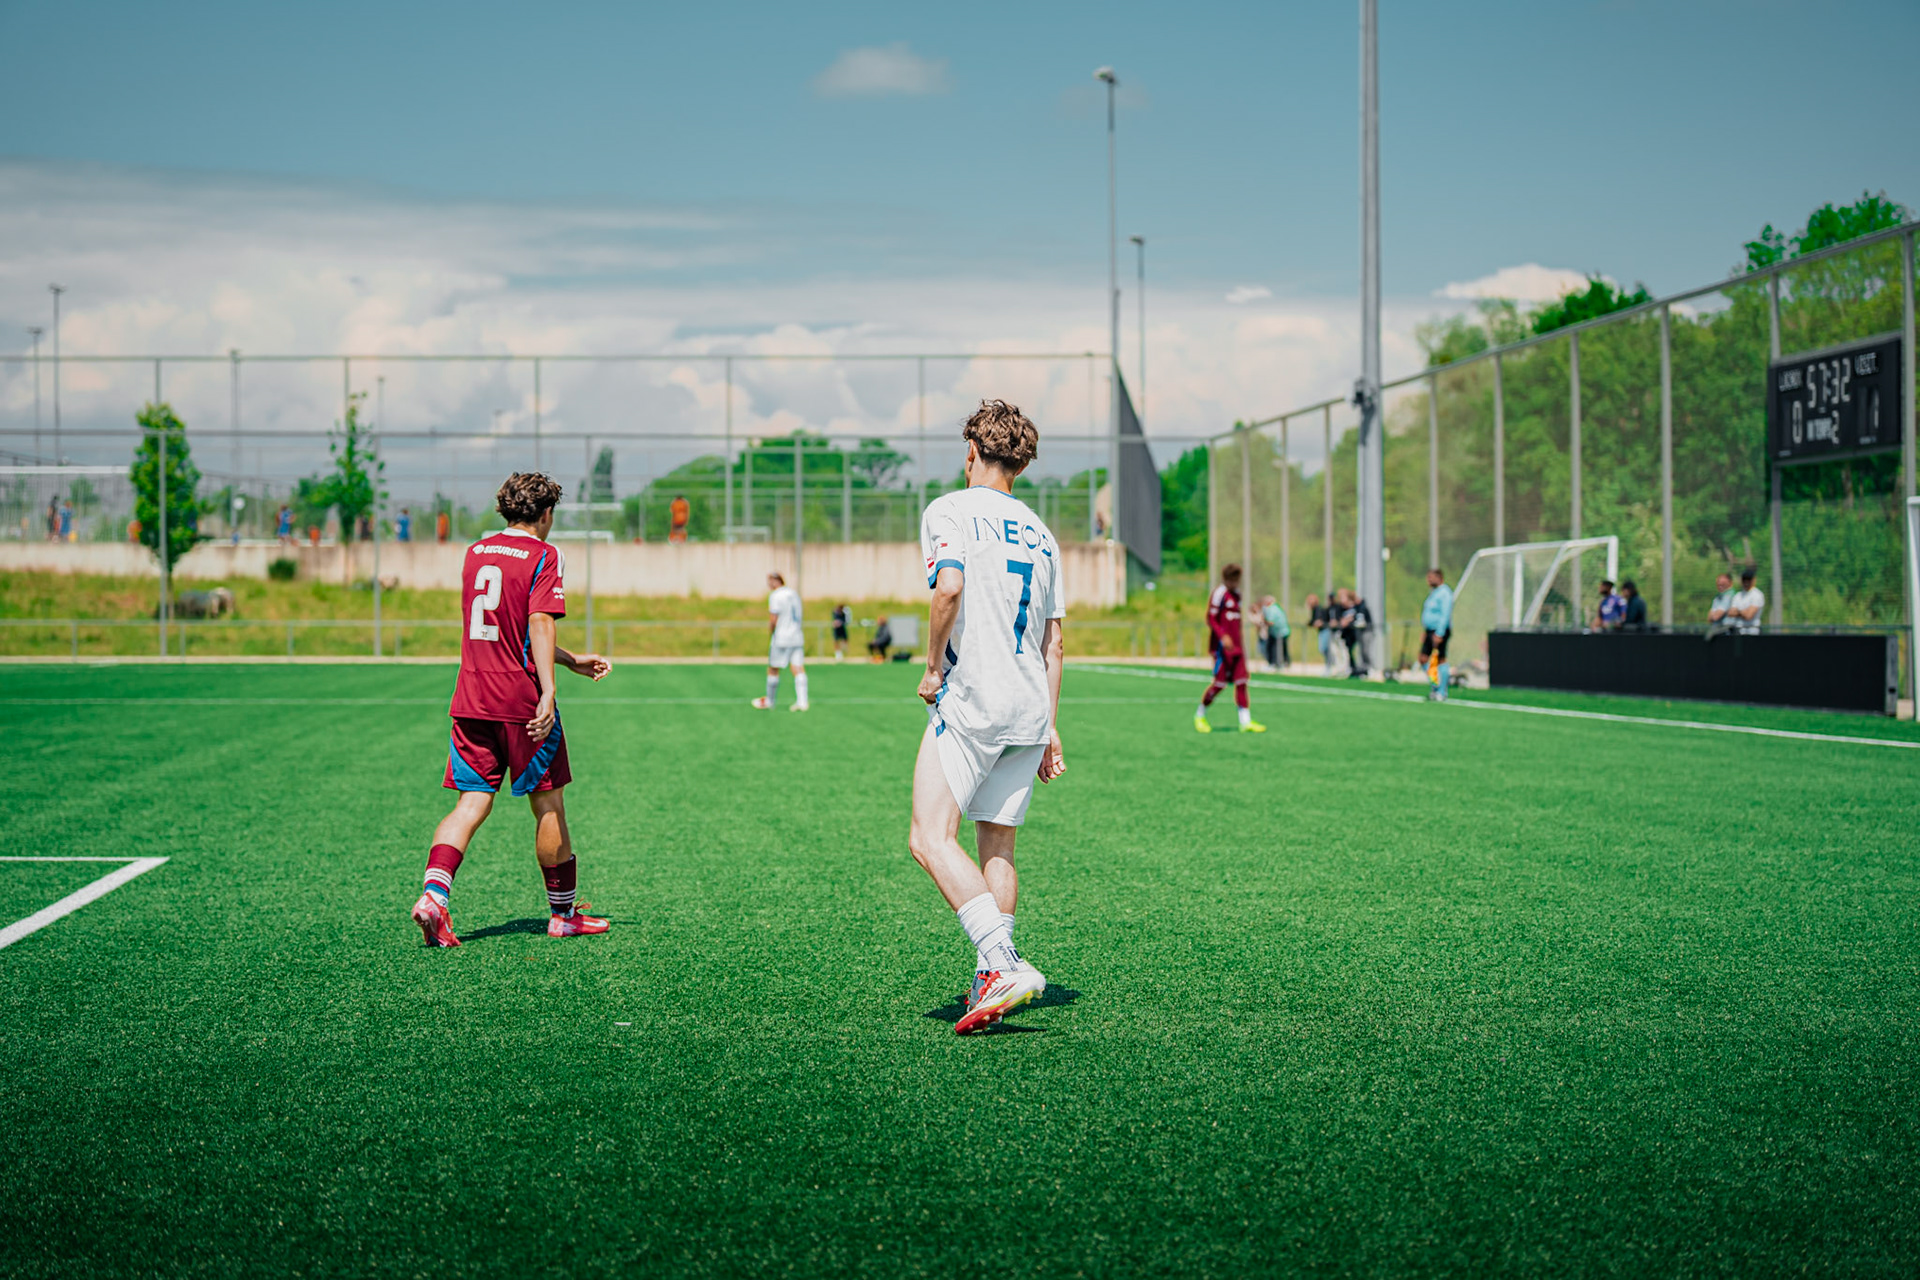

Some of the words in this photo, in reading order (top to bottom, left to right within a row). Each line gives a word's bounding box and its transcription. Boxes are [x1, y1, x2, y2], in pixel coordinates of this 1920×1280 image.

[1806, 357, 1851, 409] 57:32
[1792, 400, 1803, 444] 0
[483, 545, 530, 560] SECURITAS
[973, 517, 1052, 557] INEOS
[470, 565, 502, 642] 2
[1007, 559, 1034, 654] 7
